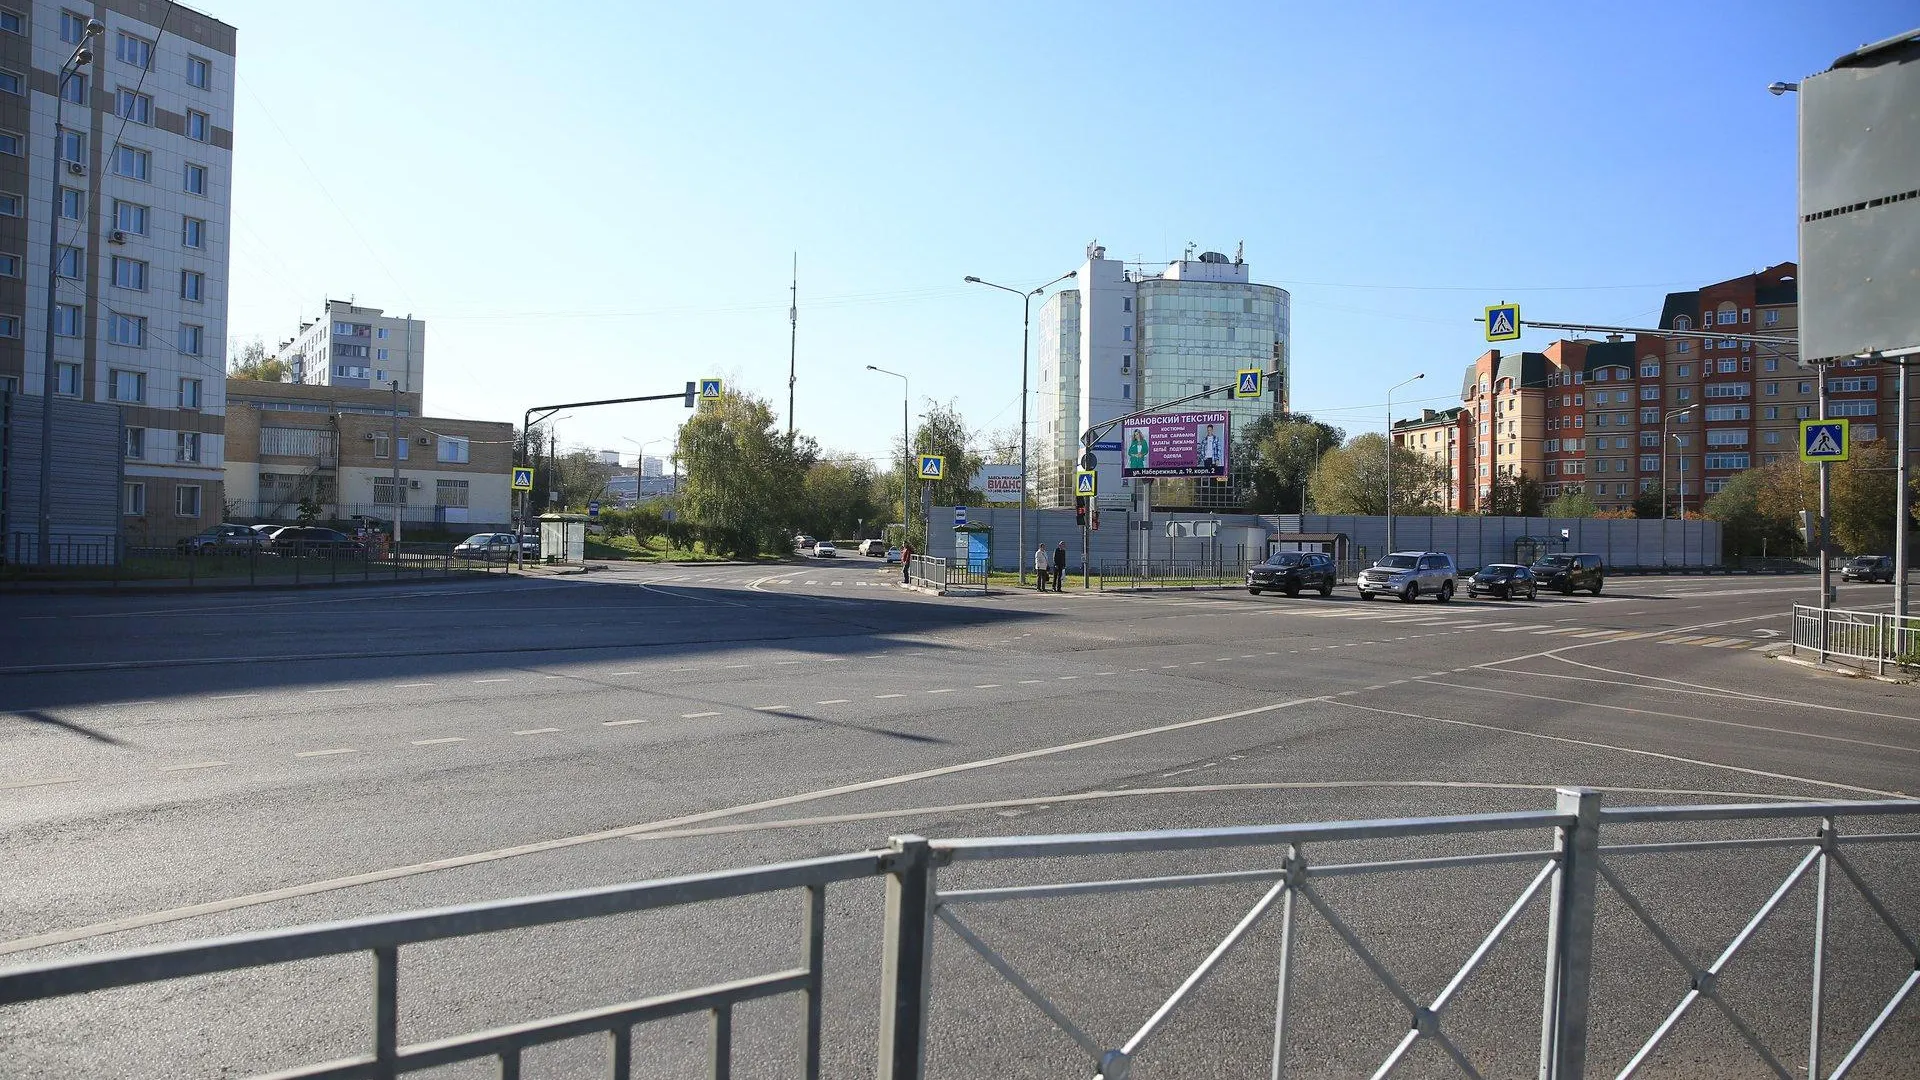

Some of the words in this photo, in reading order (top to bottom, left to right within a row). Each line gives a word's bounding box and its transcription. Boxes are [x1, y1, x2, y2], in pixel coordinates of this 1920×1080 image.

[1124, 415, 1180, 426] ИВАНОВСКИЙ
[1181, 413, 1225, 423] ТЕКСТИЛЬ
[1141, 468, 1178, 476] Набережная,
